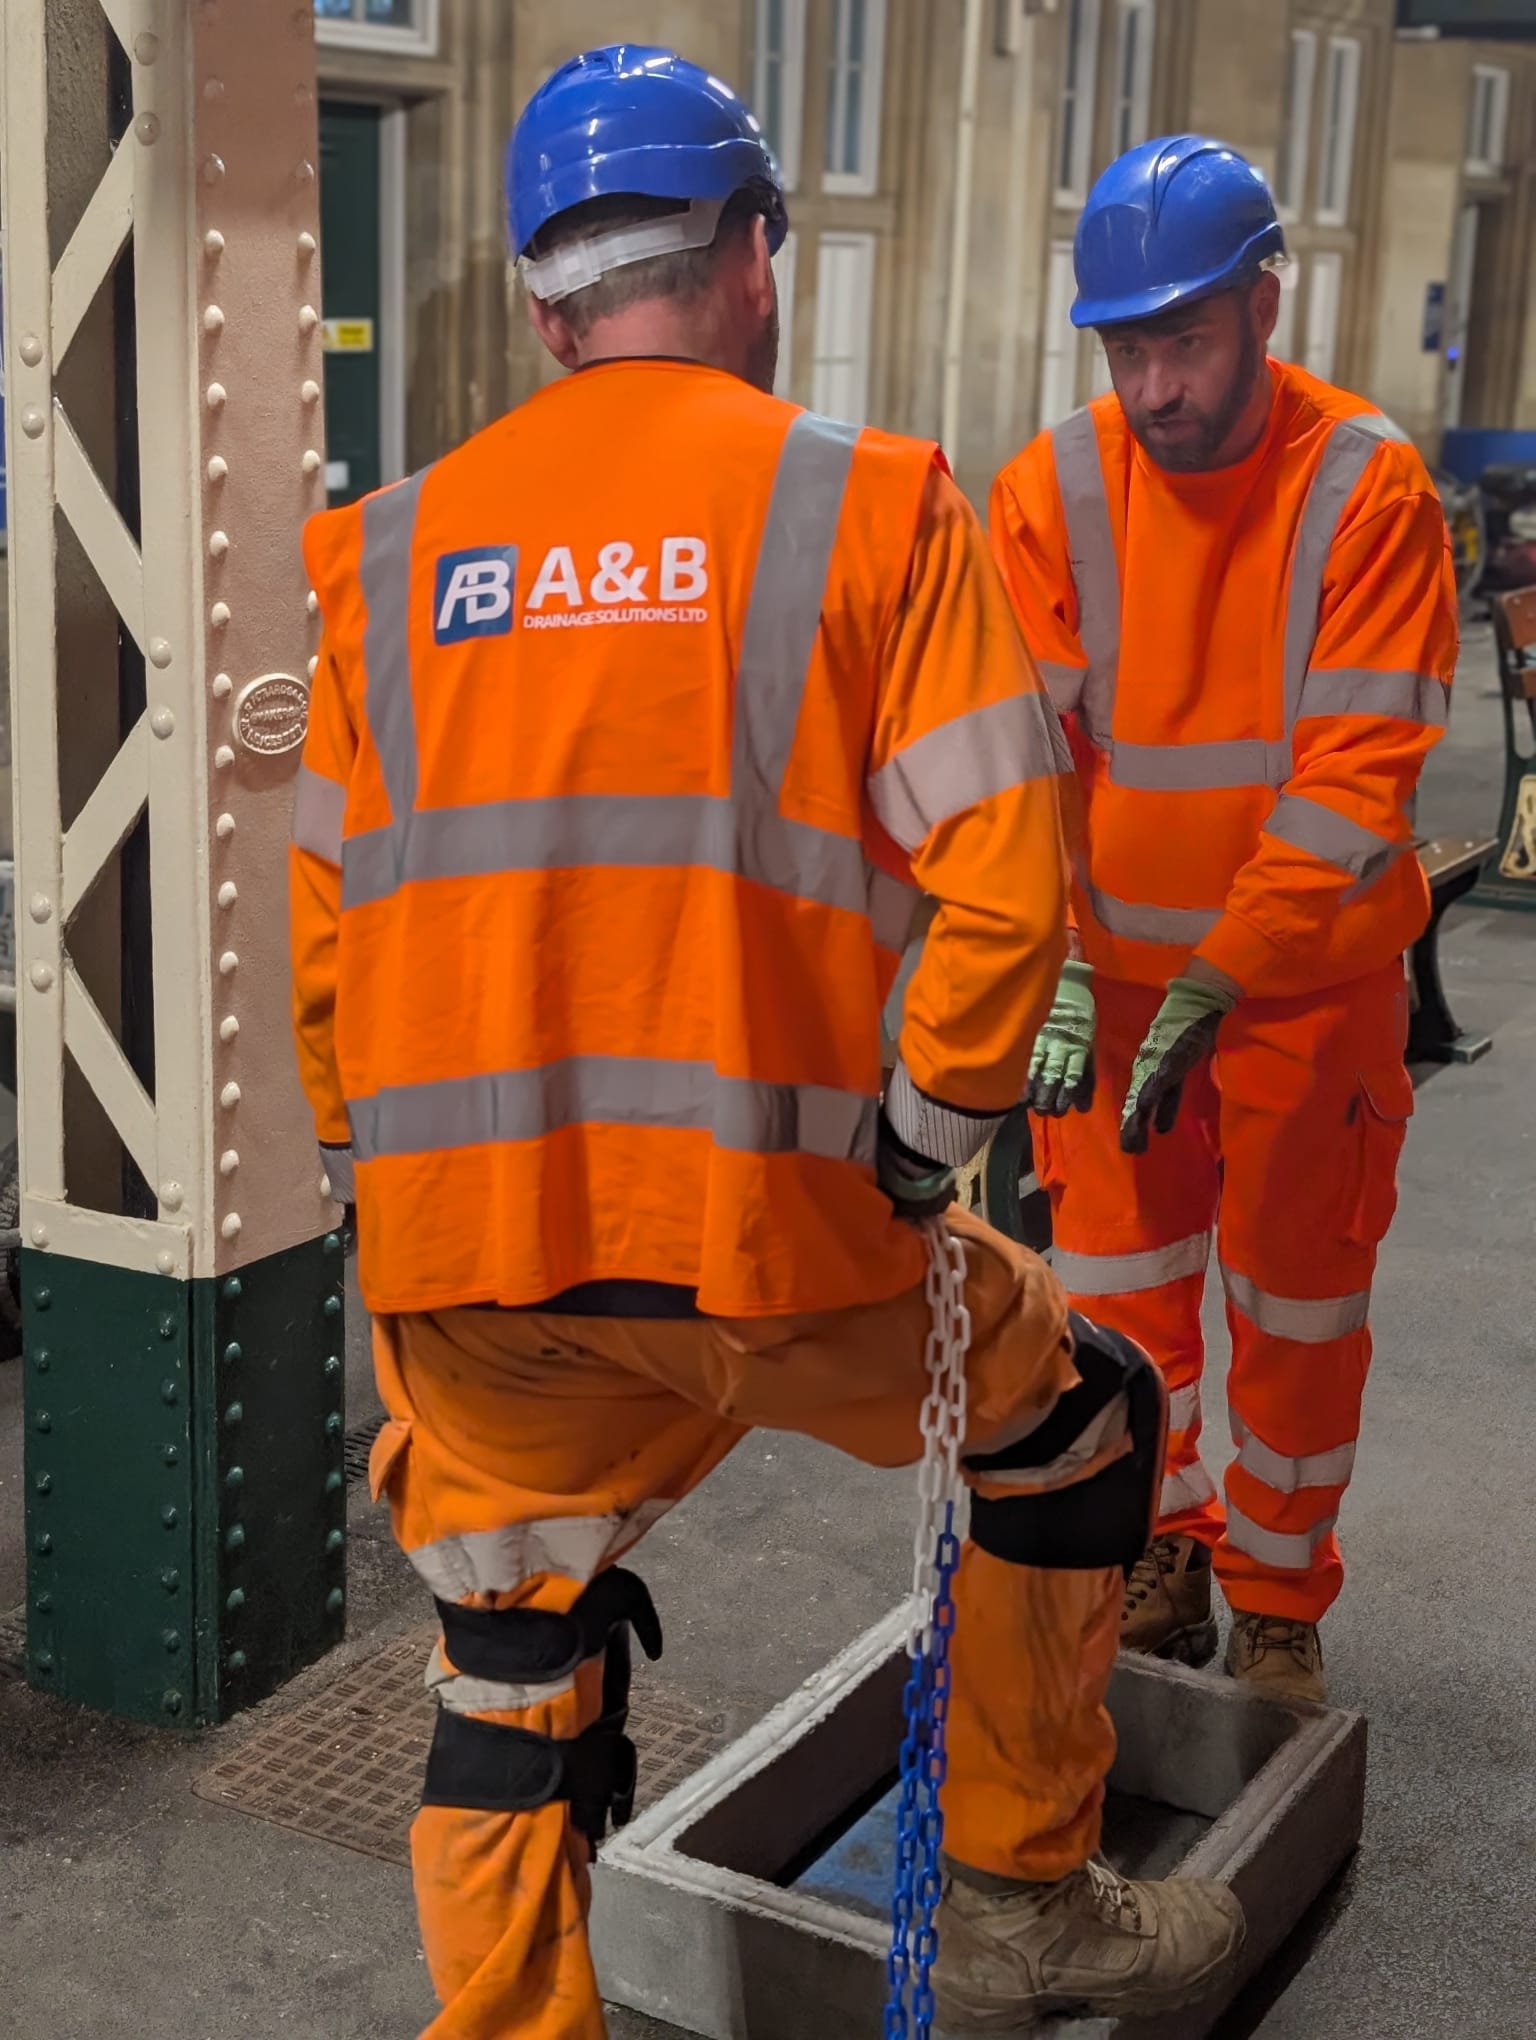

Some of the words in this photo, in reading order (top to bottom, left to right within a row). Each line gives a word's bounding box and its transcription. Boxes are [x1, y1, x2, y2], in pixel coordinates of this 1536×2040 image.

[525, 546, 584, 609] A
[590, 541, 649, 604] &
[660, 537, 709, 602] B
[679, 608, 709, 623] LTD
